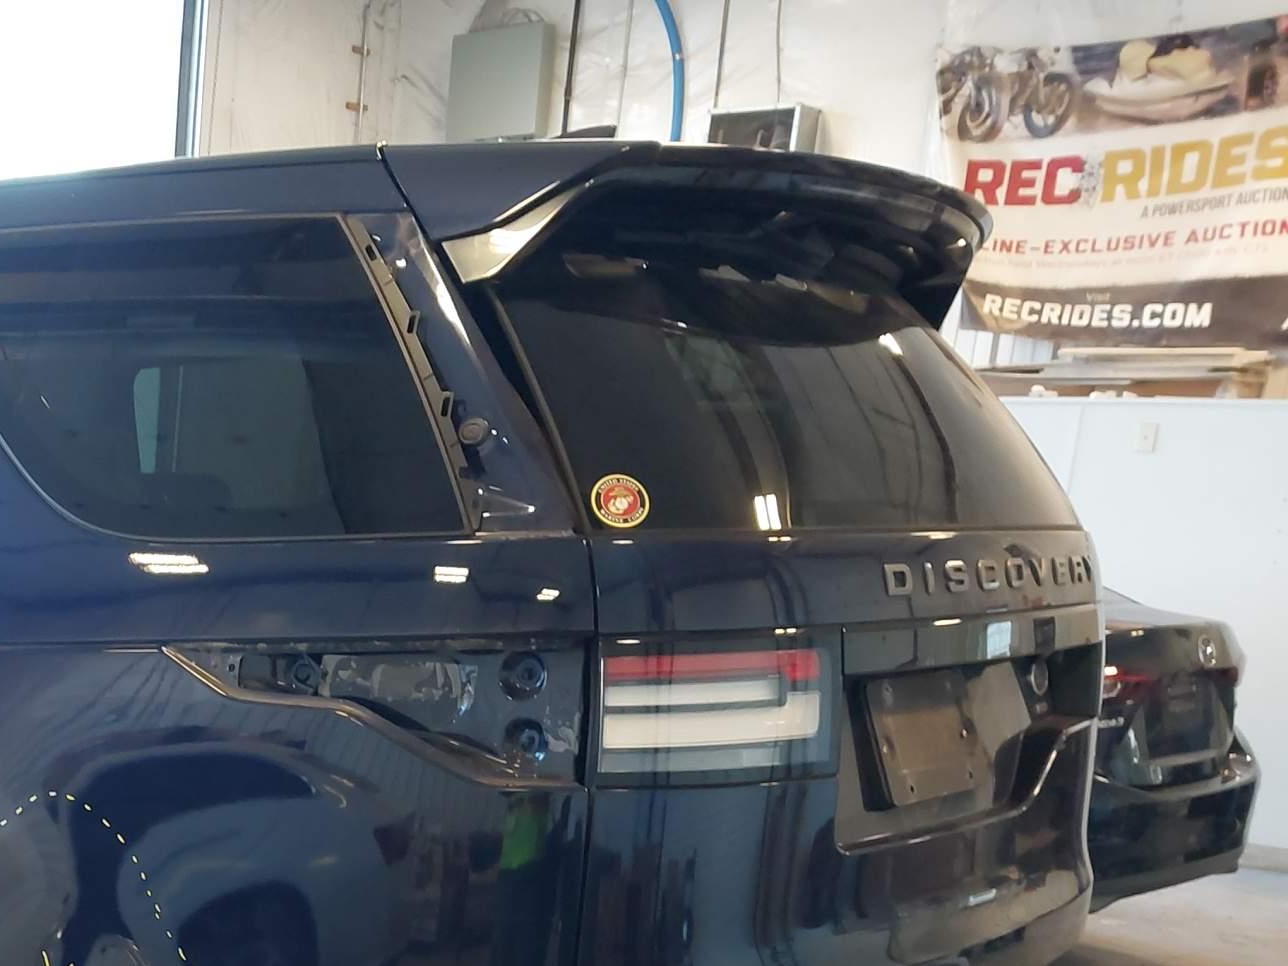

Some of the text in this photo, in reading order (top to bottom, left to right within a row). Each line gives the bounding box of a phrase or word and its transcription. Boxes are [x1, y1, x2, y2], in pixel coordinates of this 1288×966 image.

[964, 125, 1288, 206] REC RIDES
[1140, 205, 1149, 219] A
[1151, 193, 1233, 217] POWERSPORT
[982, 230, 1177, 255] INE-EXCLUSIVE
[983, 294, 1213, 329] RECRIDES.COM
